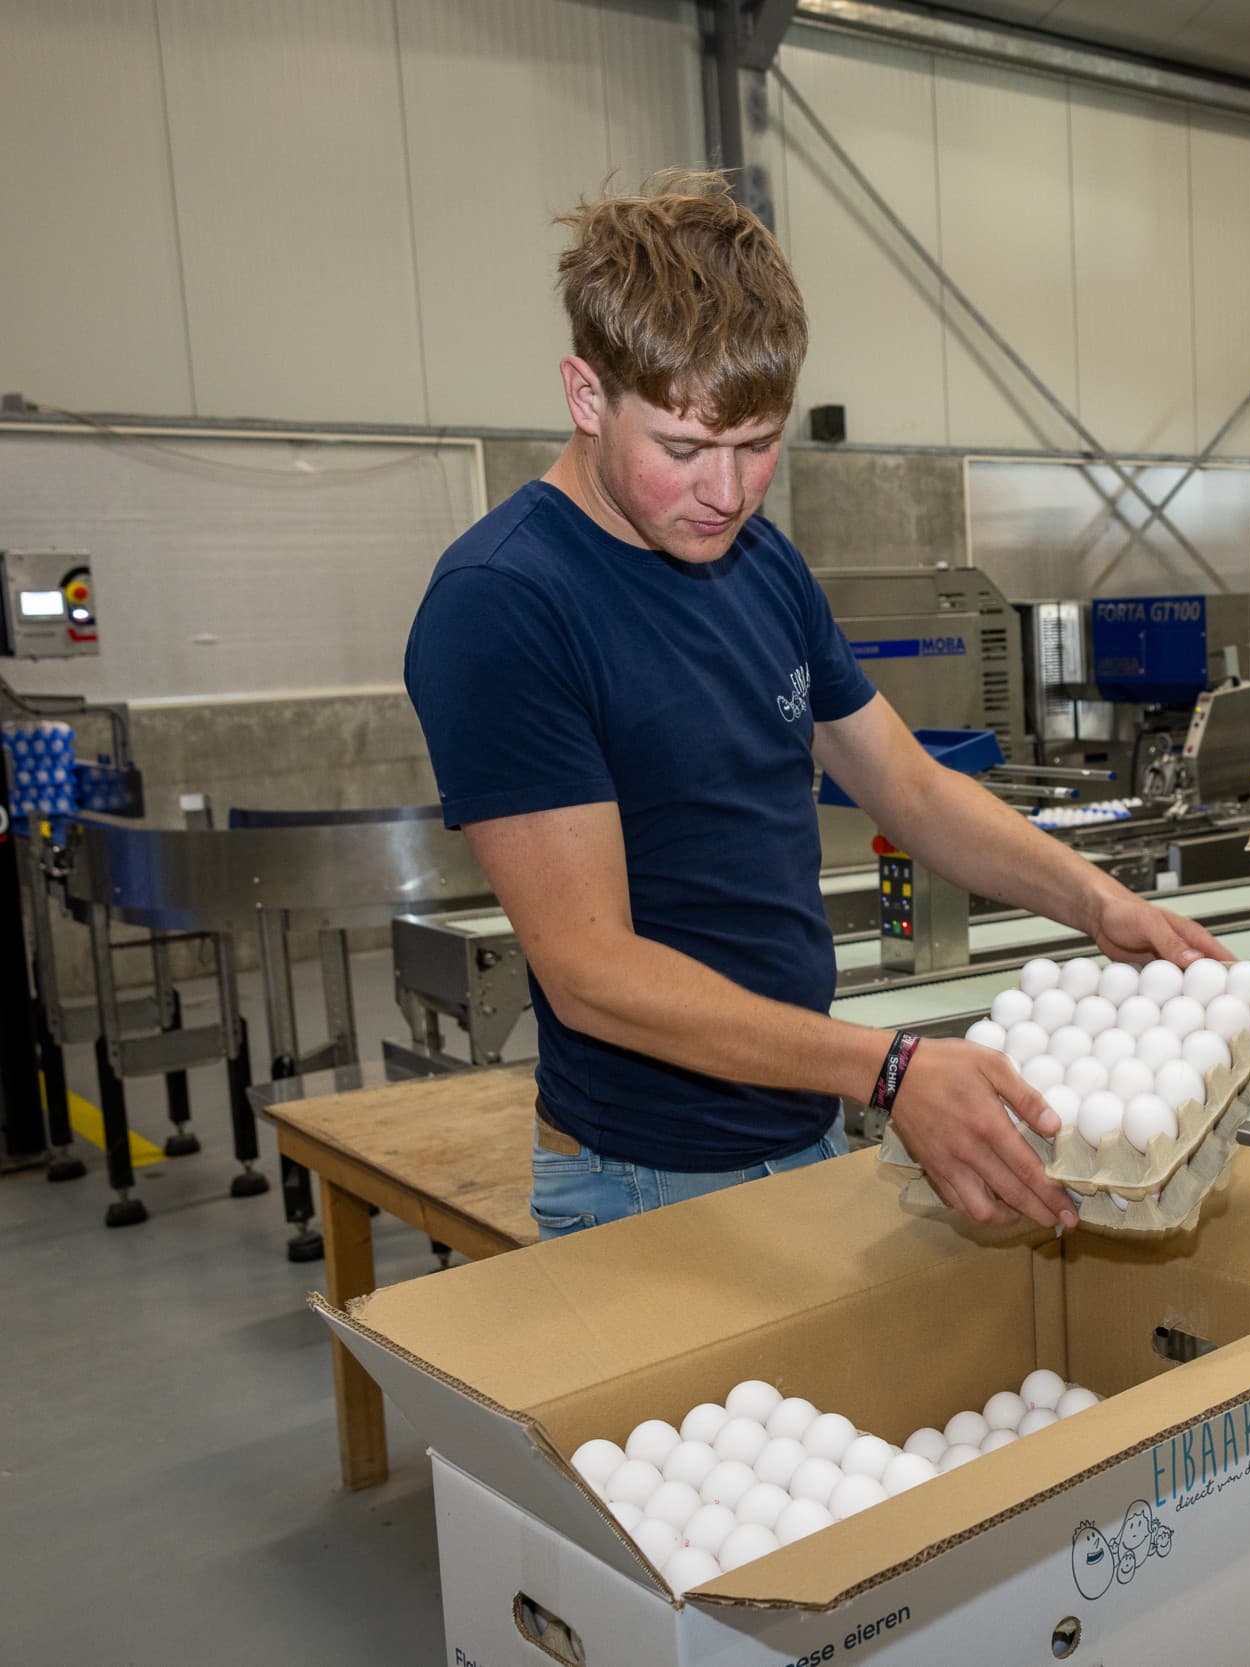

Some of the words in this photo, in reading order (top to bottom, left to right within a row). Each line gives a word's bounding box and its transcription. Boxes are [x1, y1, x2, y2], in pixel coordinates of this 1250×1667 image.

[1096, 602, 1145, 622] FORTA
[1149, 600, 1201, 622] GT100
[921, 637, 966, 651] MOBA
[1175, 1479, 1215, 1512] direct
[1217, 1471, 1243, 1492] van
[843, 1605, 911, 1650] eieren
